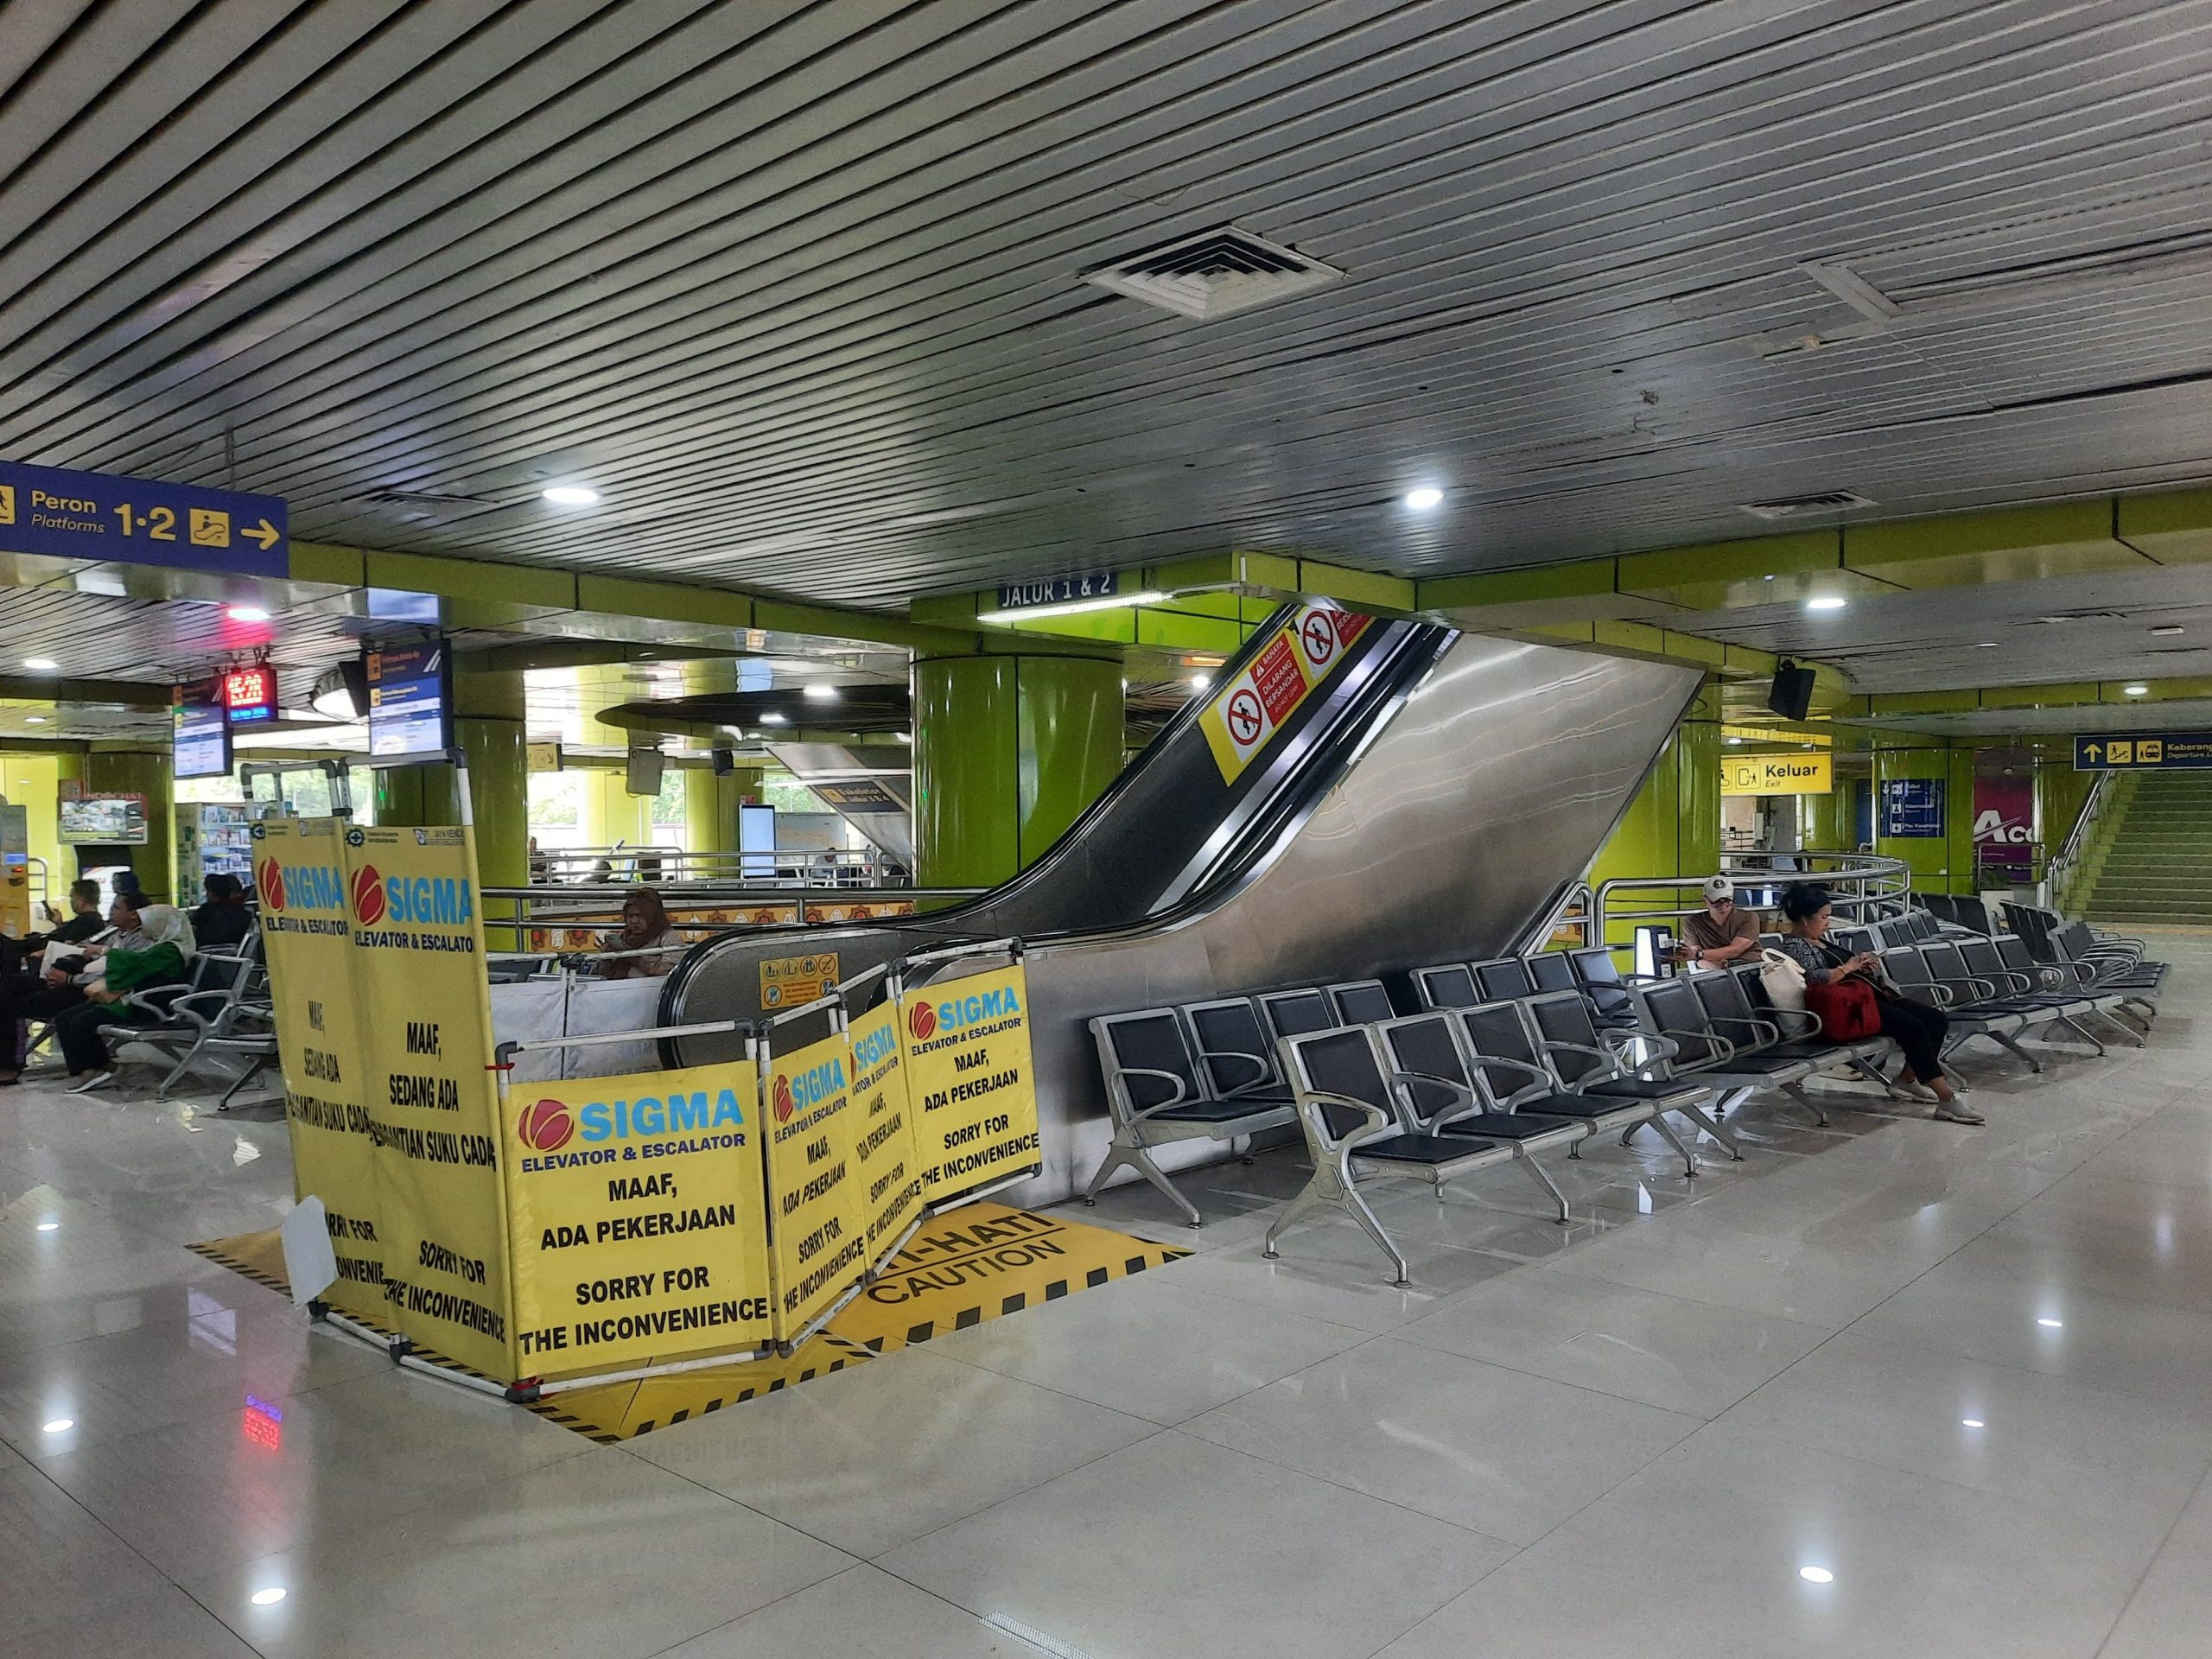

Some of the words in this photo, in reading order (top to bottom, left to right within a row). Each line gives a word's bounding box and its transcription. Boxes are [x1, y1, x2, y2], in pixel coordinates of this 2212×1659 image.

[31, 489, 97, 514] Peron
[31, 513, 105, 534] Platforms
[1002, 582, 1054, 607] JALUR
[1064, 581, 1072, 599] 1
[1081, 577, 1092, 597] &
[1101, 573, 1111, 594] 2
[1262, 640, 1285, 664] BAHAYA
[1262, 659, 1294, 696] DILARANG
[1265, 668, 1300, 709] BERSANDAR
[1765, 764, 1818, 778] Keluar
[283, 867, 346, 909] SIGMA
[386, 877, 473, 925] SIGMA
[355, 931, 409, 949] ELEVATOR
[411, 934, 420, 950] &
[422, 934, 474, 953] ESCALATO
[938, 987, 1020, 1031] SIGMA
[407, 1022, 442, 1061] MAAF,
[855, 1023, 896, 1072] SIGMA
[912, 1035, 957, 1056] ELEVATOR
[960, 1032, 967, 1042] &
[969, 1017, 1021, 1039] ESCALATOR
[871, 1073, 876, 1084] &
[954, 1049, 989, 1072] MAAF,
[390, 1074, 435, 1109] SEDANG
[438, 1078, 459, 1111] ADA
[791, 1058, 846, 1111] SIGMA
[925, 1090, 948, 1113] ADA
[951, 1069, 1018, 1104] PEKERJAAN
[580, 1089, 744, 1142] SIGMA
[775, 1118, 810, 1144] ELEVATOR
[808, 1114, 814, 1126] &
[813, 1096, 847, 1122] ESCALATOR
[869, 1092, 887, 1119] MAAF,
[427, 1130, 459, 1164] SUKU
[807, 1135, 830, 1166] MAAF,
[856, 1140, 871, 1164] ADA
[868, 1112, 902, 1154] PEKERJAAN
[944, 1124, 980, 1149] SORRY
[984, 1114, 1008, 1136] FOR
[522, 1148, 616, 1173] ELEVATOR
[622, 1147, 637, 1160] &
[642, 1133, 746, 1159] ESCALATOR
[921, 1166, 940, 1189] THE
[944, 1132, 1039, 1179] INCONVENIENCE
[608, 1173, 677, 1202] MAAF,
[783, 1189, 799, 1217] ADA
[802, 1160, 846, 1205] PEKERJAAN
[870, 1173, 891, 1204] SORRY
[891, 1162, 904, 1187] FOR
[325, 1213, 350, 1238] RRY
[349, 1219, 378, 1242] FOR
[541, 1224, 589, 1250] ADA
[597, 1205, 735, 1243] PEKERJAAN
[876, 1179, 921, 1237] INCONVENIENCE
[798, 1230, 823, 1264] SORRY
[823, 1217, 842, 1243] FOR
[335, 1256, 385, 1285] ONVENIE
[419, 1240, 458, 1274] SORRY
[459, 1255, 486, 1285] FOR
[800, 1236, 864, 1303] INCONVENIENCE
[867, 1239, 1067, 1304] CAUTION
[576, 1274, 655, 1306] SORRY
[664, 1266, 709, 1294] FOR
[384, 1279, 407, 1307] THE
[408, 1285, 505, 1344] INCONVENIENCE
[519, 1326, 567, 1355] THE
[575, 1298, 768, 1345] INCONVENIENCE
